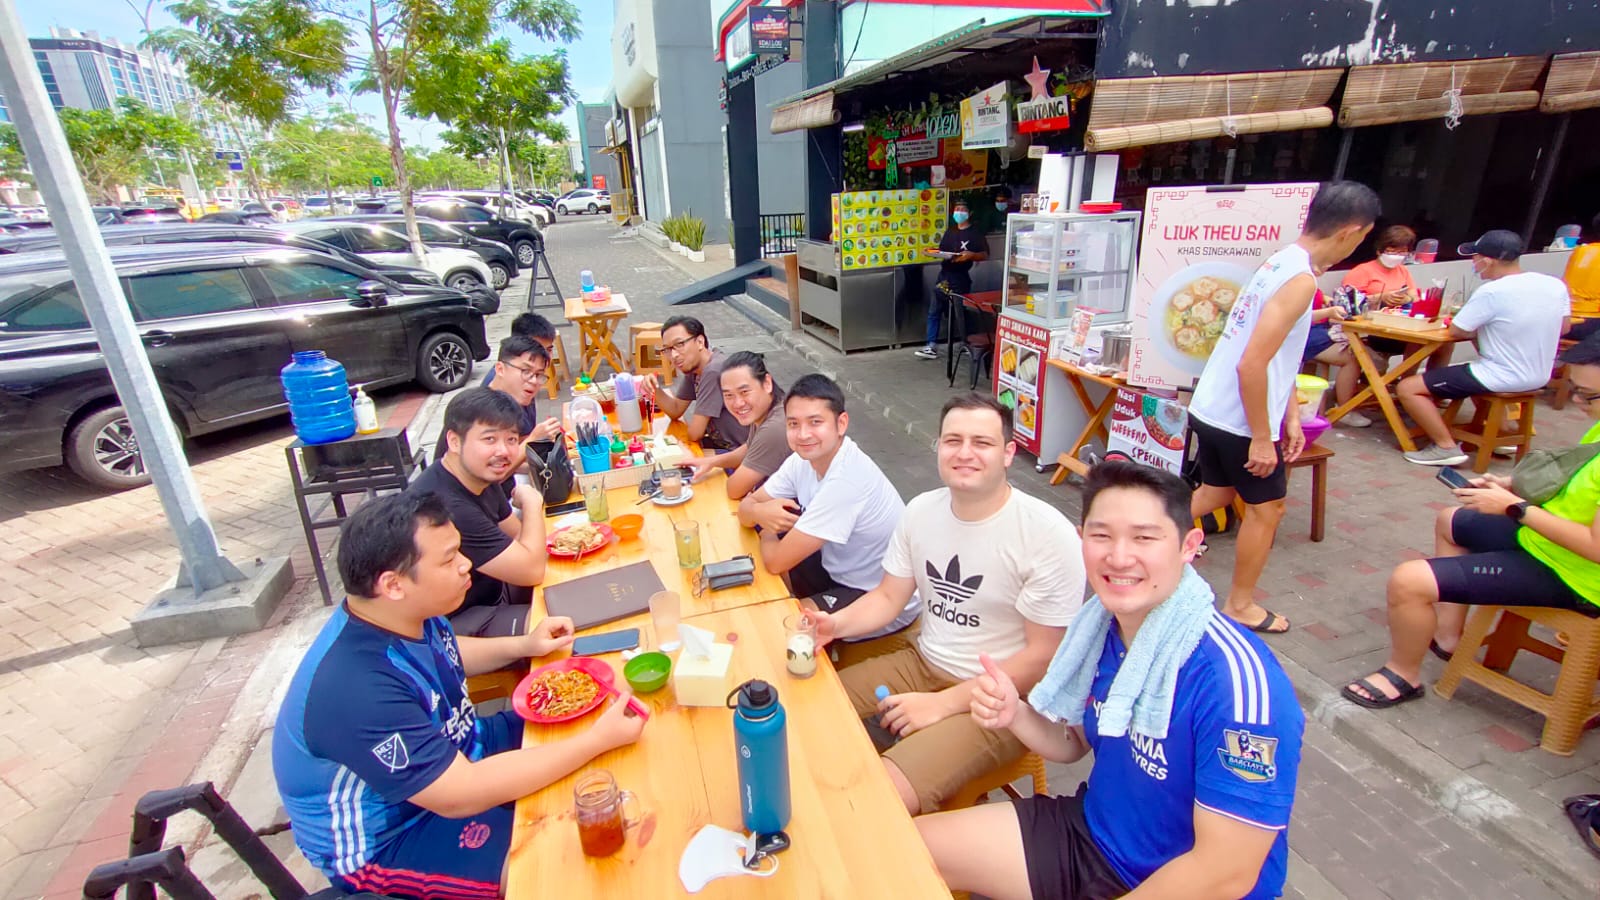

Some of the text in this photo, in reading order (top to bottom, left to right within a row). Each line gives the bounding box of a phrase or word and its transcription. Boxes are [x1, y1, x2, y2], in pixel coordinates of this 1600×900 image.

[978, 106, 1000, 117] BINTANG
[1020, 100, 1065, 121] BINTANG
[1040, 196, 1050, 211] 27
[1164, 224, 1281, 241] LIUK THEU SAN
[1177, 246, 1262, 257] KHAS SINGKAWANG
[1117, 388, 1136, 403] Nasi
[1114, 403, 1136, 417] Uduk
[1111, 421, 1147, 444] WEEKEND
[1473, 566, 1503, 575] MAAP
[376, 742, 393, 755] MLS
[1228, 756, 1265, 772] BARCLAYS
